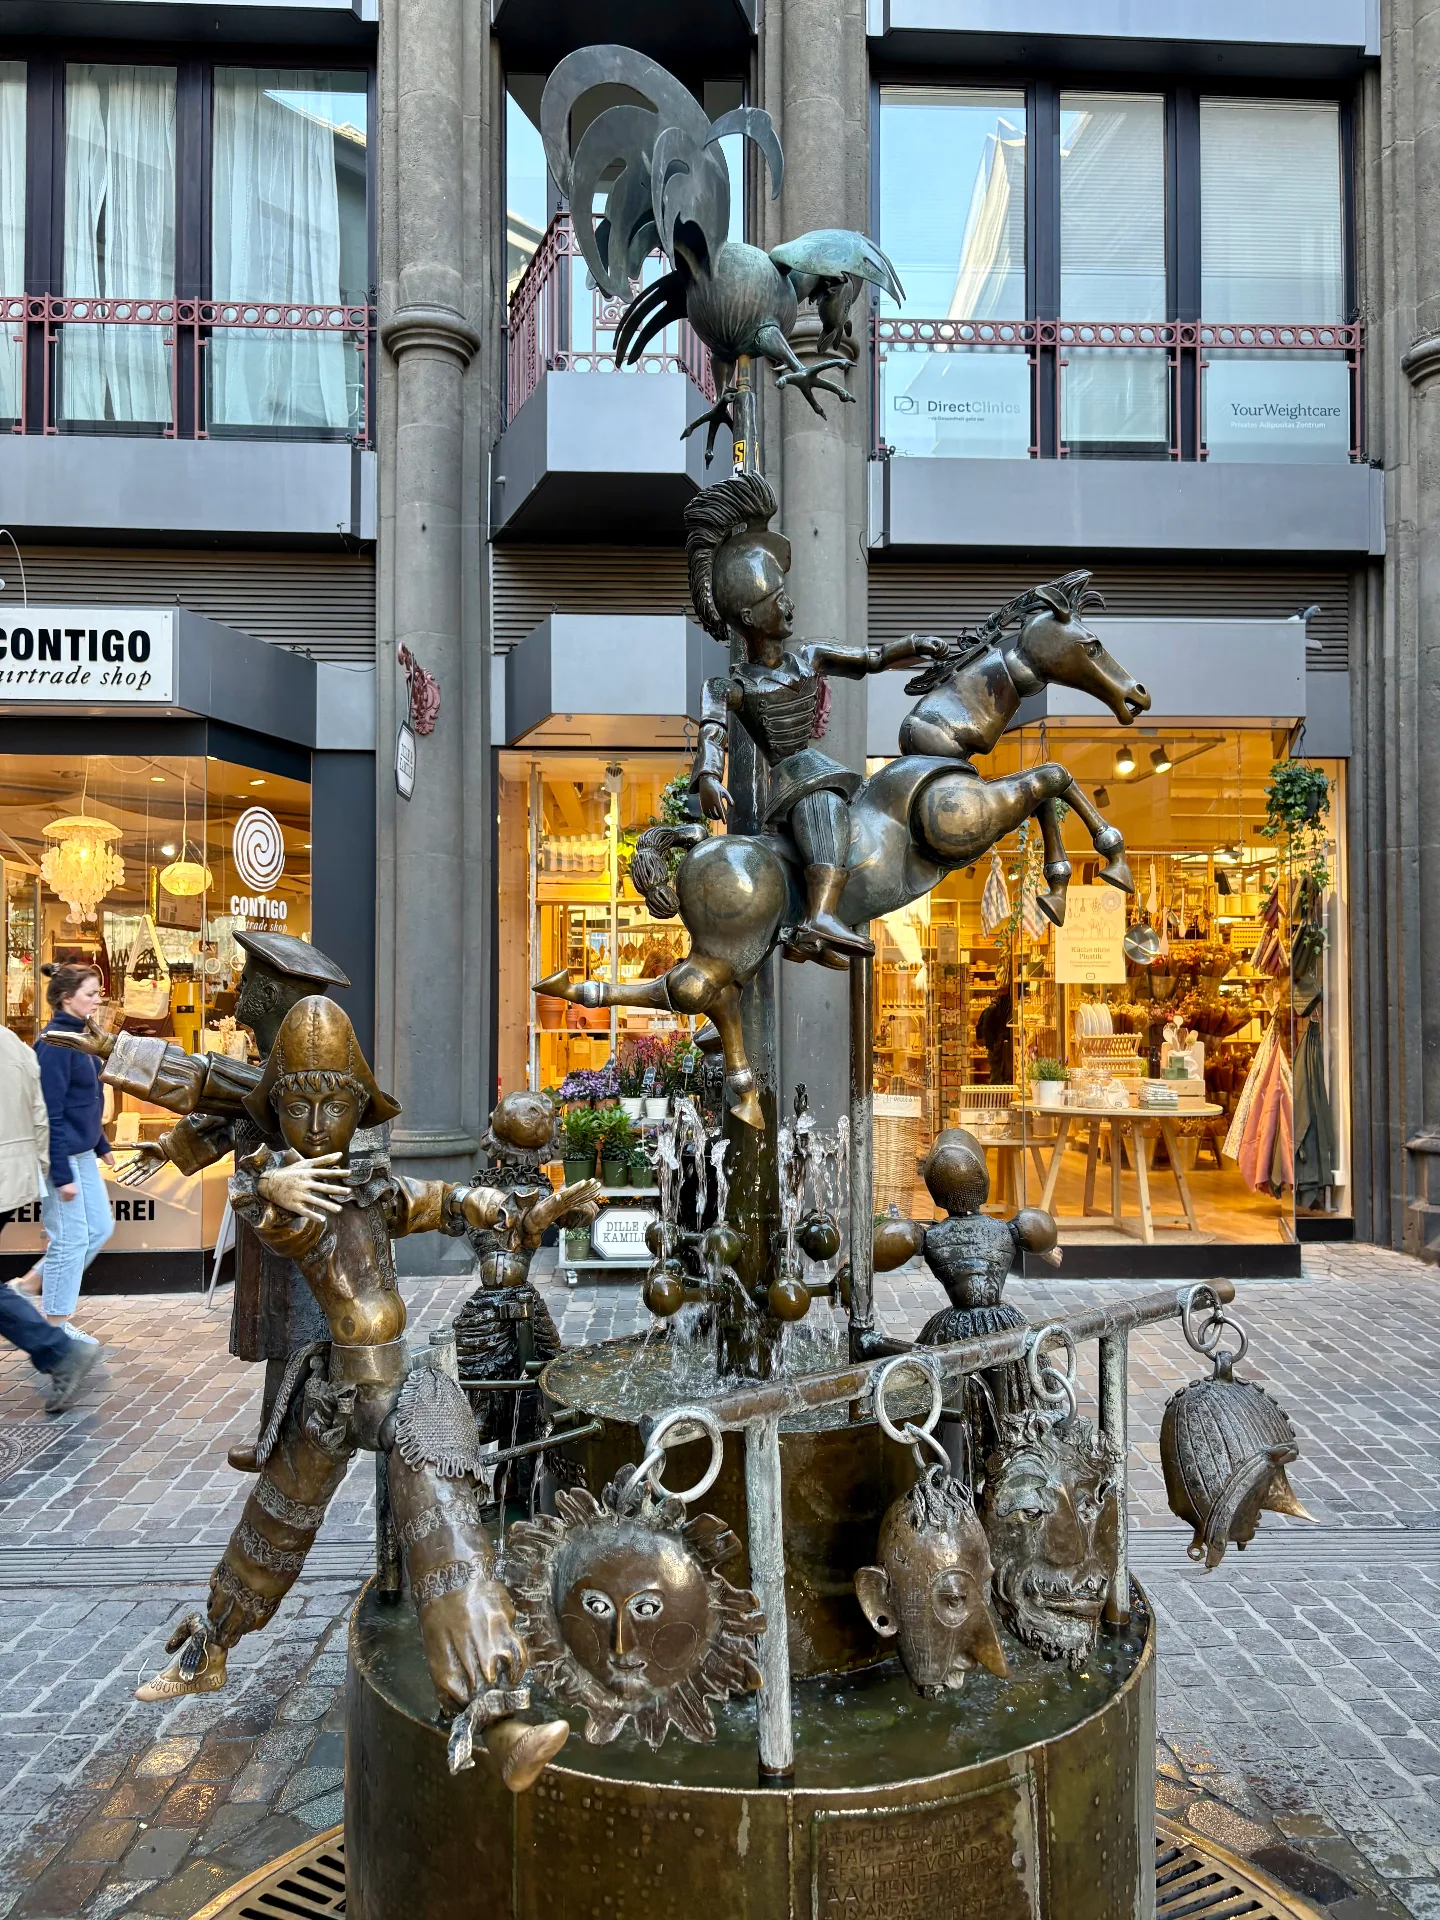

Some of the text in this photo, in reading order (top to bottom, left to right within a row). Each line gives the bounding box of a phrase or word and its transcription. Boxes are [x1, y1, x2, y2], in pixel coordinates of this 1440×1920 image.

[928, 400, 1020, 414] DirectClinics
[1231, 403, 1341, 420] YourWeightcare
[0, 666, 151, 690] irtrade shop
[231, 895, 287, 920] CONTIGO
[229, 917, 268, 931] fatrade
[110, 1200, 154, 1221] REI
[606, 1222, 638, 1232] DILLE
[603, 1232, 646, 1242] KAMIL
[924, 1849, 965, 1871] VON
